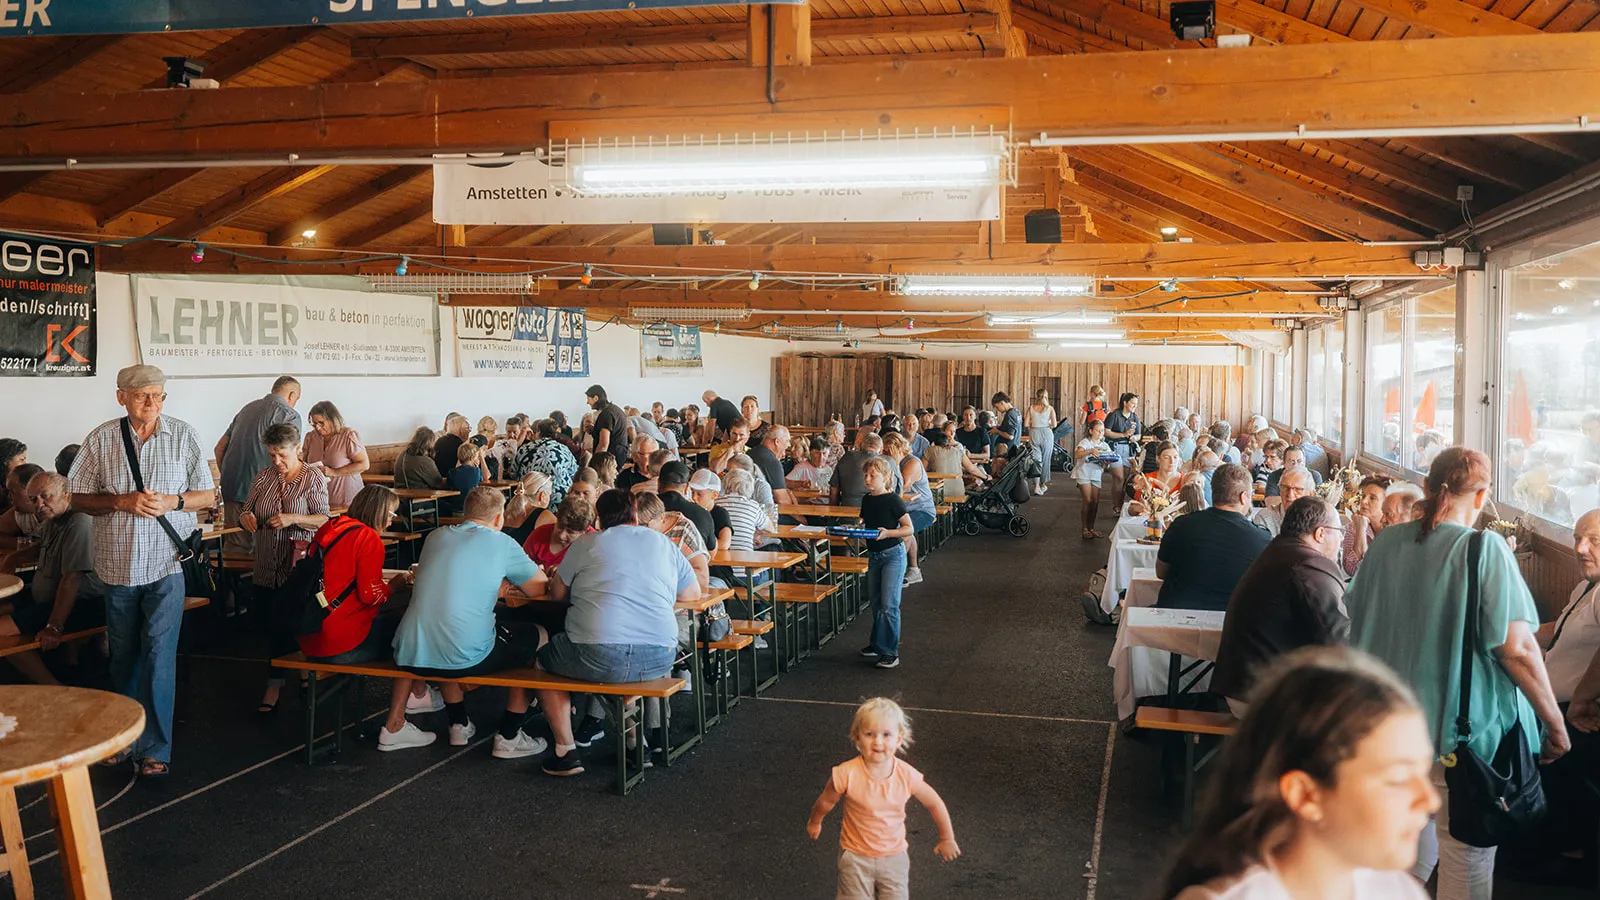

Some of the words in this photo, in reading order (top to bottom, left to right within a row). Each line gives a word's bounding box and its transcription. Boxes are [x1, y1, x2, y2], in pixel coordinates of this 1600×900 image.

[467, 187, 547, 200] Amstetten
[150, 295, 299, 346] LEHNER
[305, 306, 325, 321] bau
[329, 307, 337, 321] &
[340, 309, 369, 324] beton
[371, 313, 380, 325] in
[383, 313, 426, 328] perfektion
[462, 308, 514, 336] wagner
[518, 310, 545, 335] auto
[150, 348, 199, 357] BAUMEISTER
[207, 348, 253, 357] FERTIGTEILE
[320, 342, 341, 351] LEHNER
